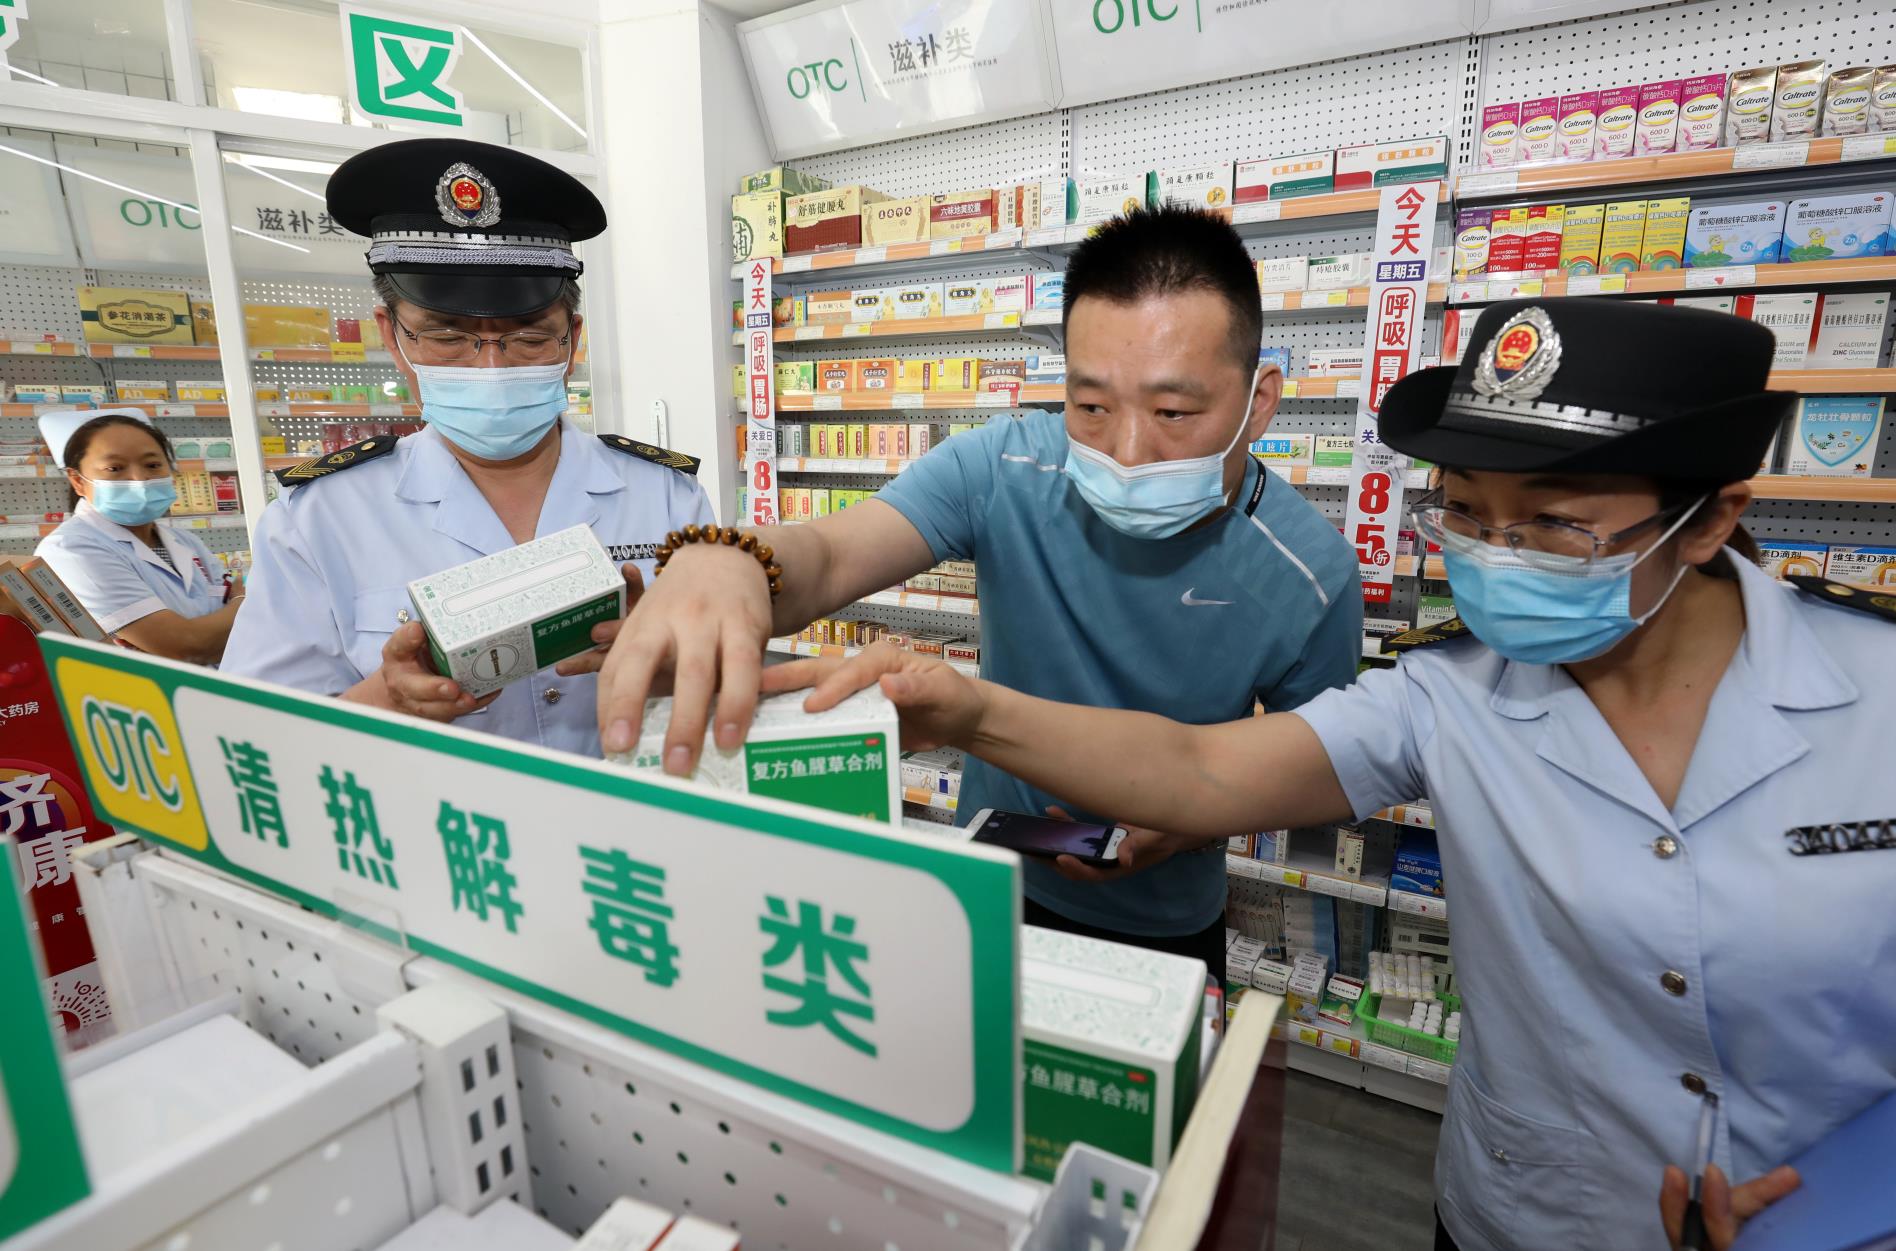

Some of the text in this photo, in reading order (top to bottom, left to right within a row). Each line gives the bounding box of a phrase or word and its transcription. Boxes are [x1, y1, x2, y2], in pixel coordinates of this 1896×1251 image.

[888, 27, 975, 74] 滋补类
[348, 13, 463, 126] 区
[786, 57, 849, 101] OTC
[1736, 96, 1769, 107] Caltrate
[1782, 90, 1817, 102] Caltrate
[1833, 96, 1868, 108] Caltrate
[1644, 108, 1675, 120] Caltrate
[1686, 104, 1719, 114] Caltrate
[1564, 118, 1593, 129] Caltrate
[1603, 114, 1633, 124] Caltrate
[1487, 129, 1515, 138] Caltrate
[1525, 124, 1553, 134] Caltrate
[798, 198, 846, 217] 舒筋健腰丸
[940, 202, 982, 216] 六味地黄胶囊
[1797, 204, 1882, 219] 葡萄糖酸锌口服溶液
[1390, 187, 1426, 256] 今天
[1698, 213, 1776, 227] 葡萄糖酸锌口服溶液
[1461, 234, 1488, 242] Caltrate
[1378, 263, 1421, 280] 星期五
[751, 262, 766, 310] 今天
[106, 311, 168, 323] 参花消渴茶
[748, 314, 770, 327] 星期五
[124, 390, 144, 400] AD
[183, 390, 203, 400] AD
[1807, 412, 1872, 422] 龙牡壮骨颗粒
[752, 430, 773, 441] 关爱日
[1375, 552, 1388, 564] 折
[1421, 605, 1449, 614] Vitamin
[537, 598, 618, 637] 复方鱼腥草合剂
[82, 693, 184, 813] OTC
[752, 751, 883, 782] 复方鱼腥草合剂
[217, 736, 877, 1058] 清热解毒类
